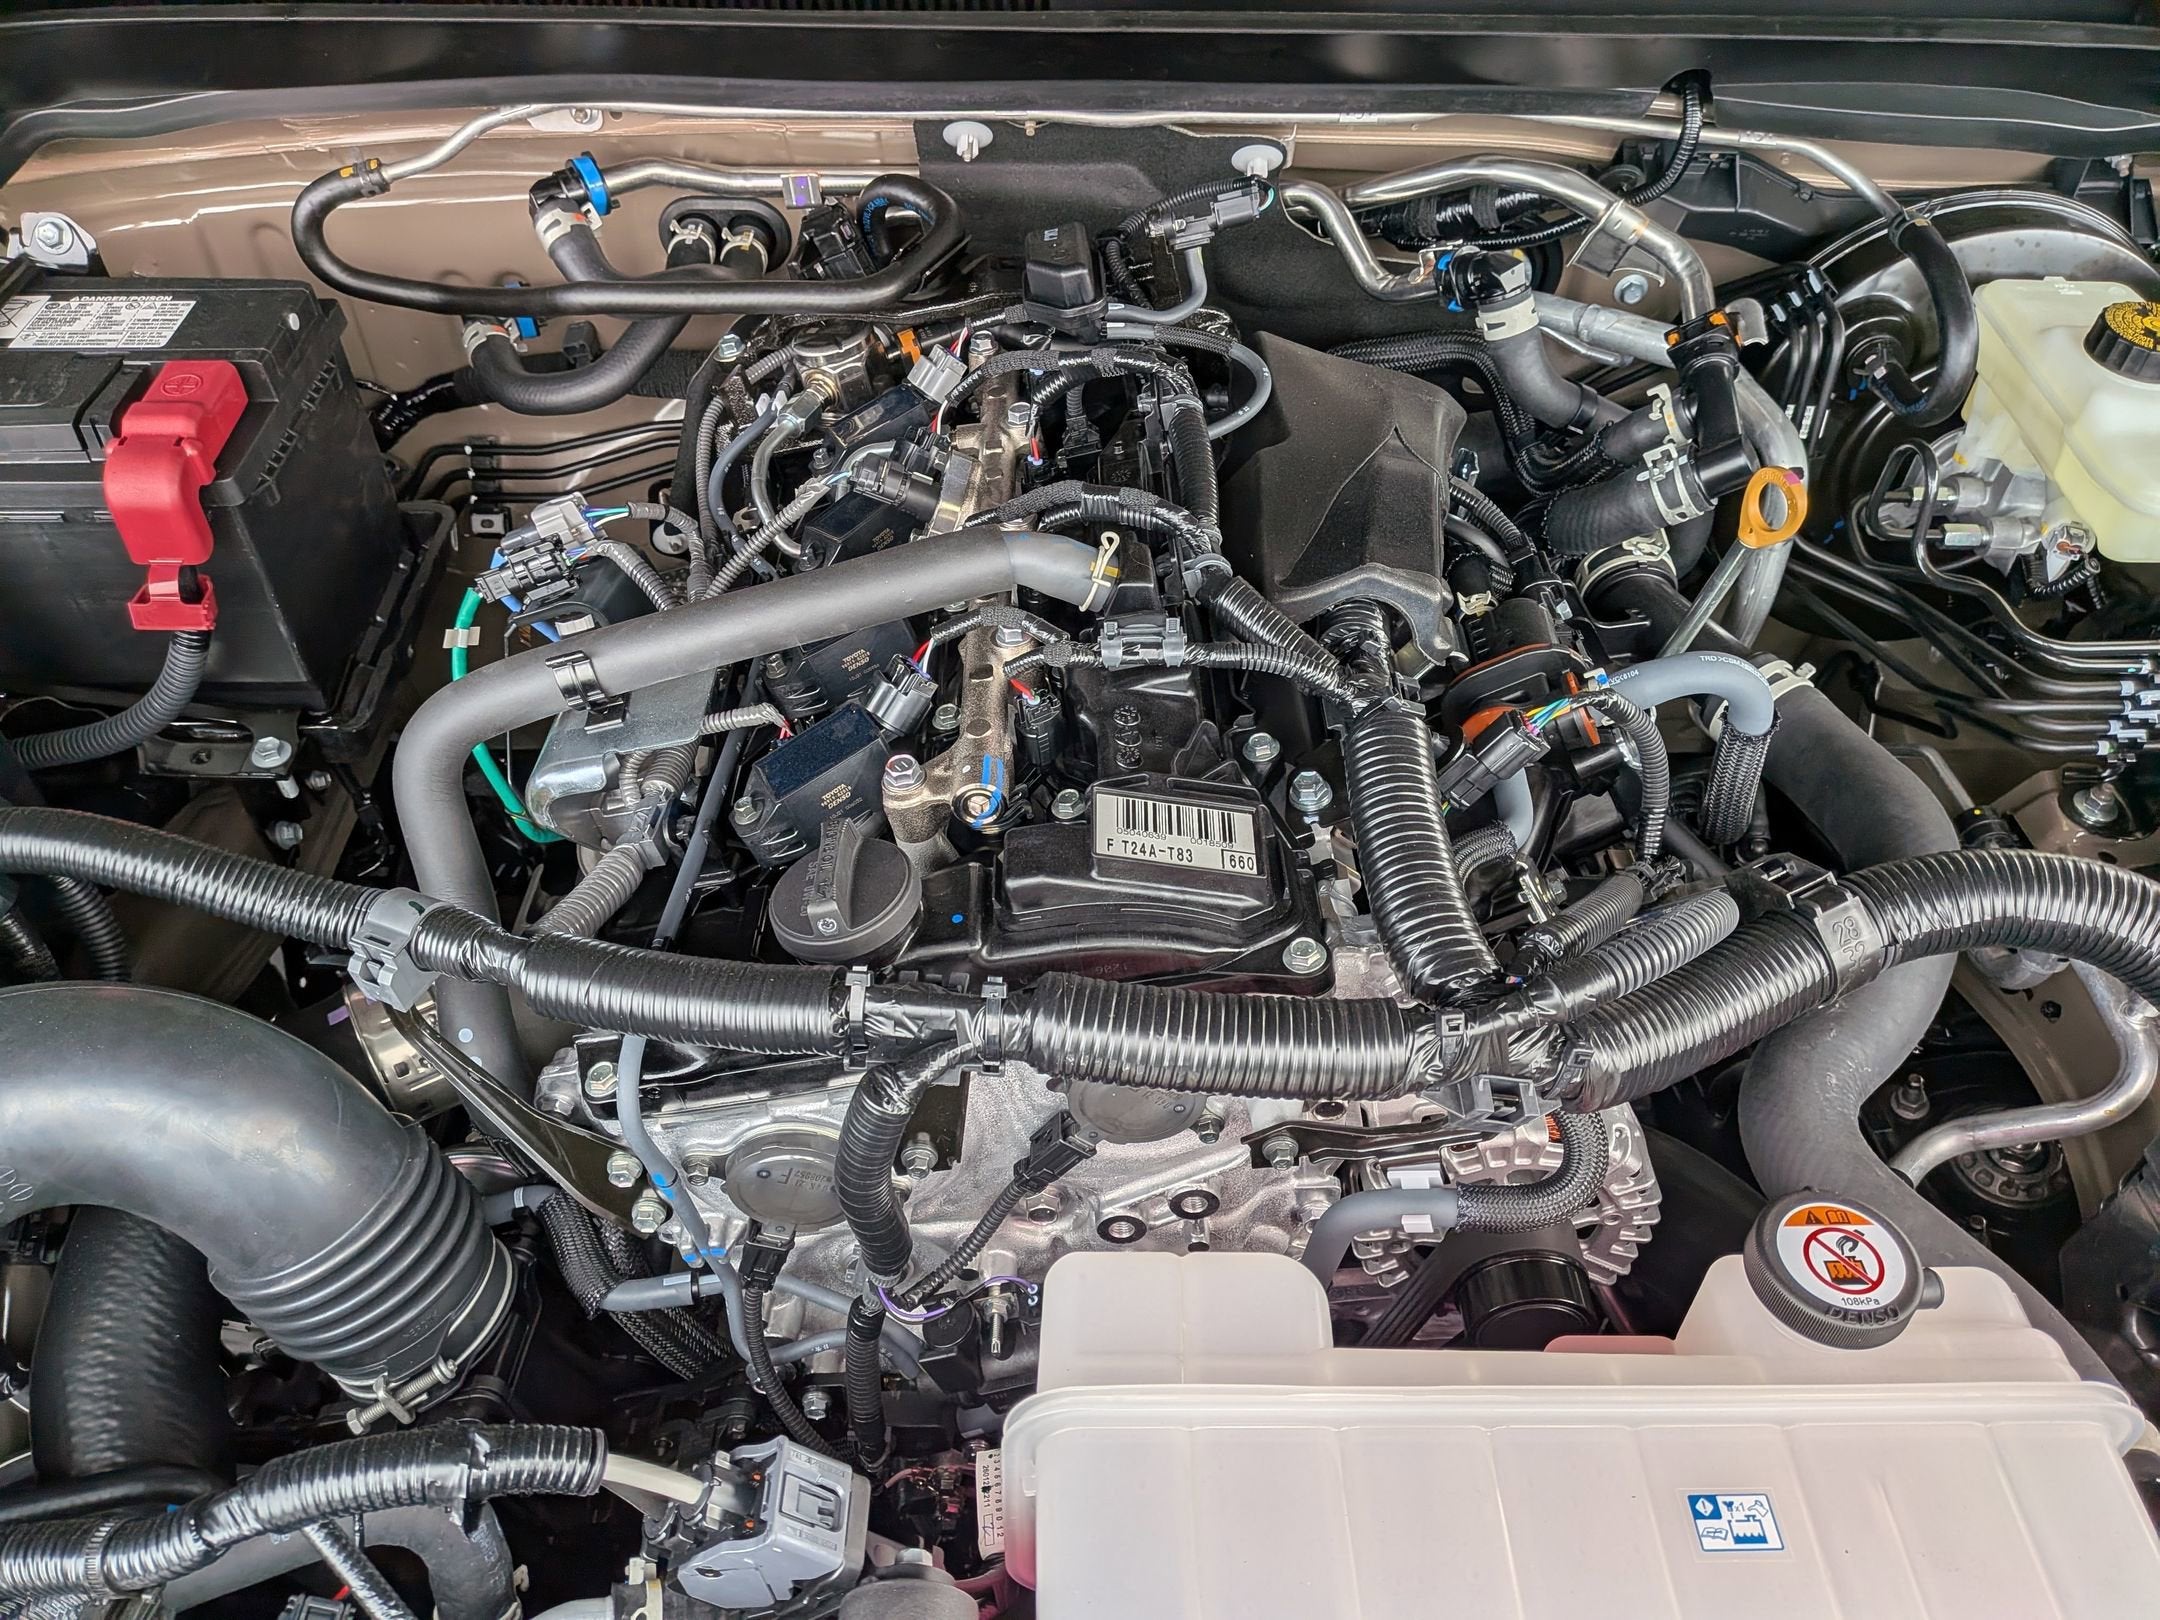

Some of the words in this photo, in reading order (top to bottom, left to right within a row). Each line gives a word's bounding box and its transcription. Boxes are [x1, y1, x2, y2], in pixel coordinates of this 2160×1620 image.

[842, 649, 866, 662] TOYOTA
[822, 783, 847, 801] TOYOTA
[828, 791, 851, 810] DENSO
[1106, 838, 1114, 852] F
[1122, 840, 1193, 863] T24A-T83
[805, 862, 819, 881] SAE
[1229, 854, 1254, 870] 660
[1832, 915, 1861, 947] 28
[1841, 1297, 1880, 1306] 108kPa
[1825, 1305, 1901, 1326] DENSO
